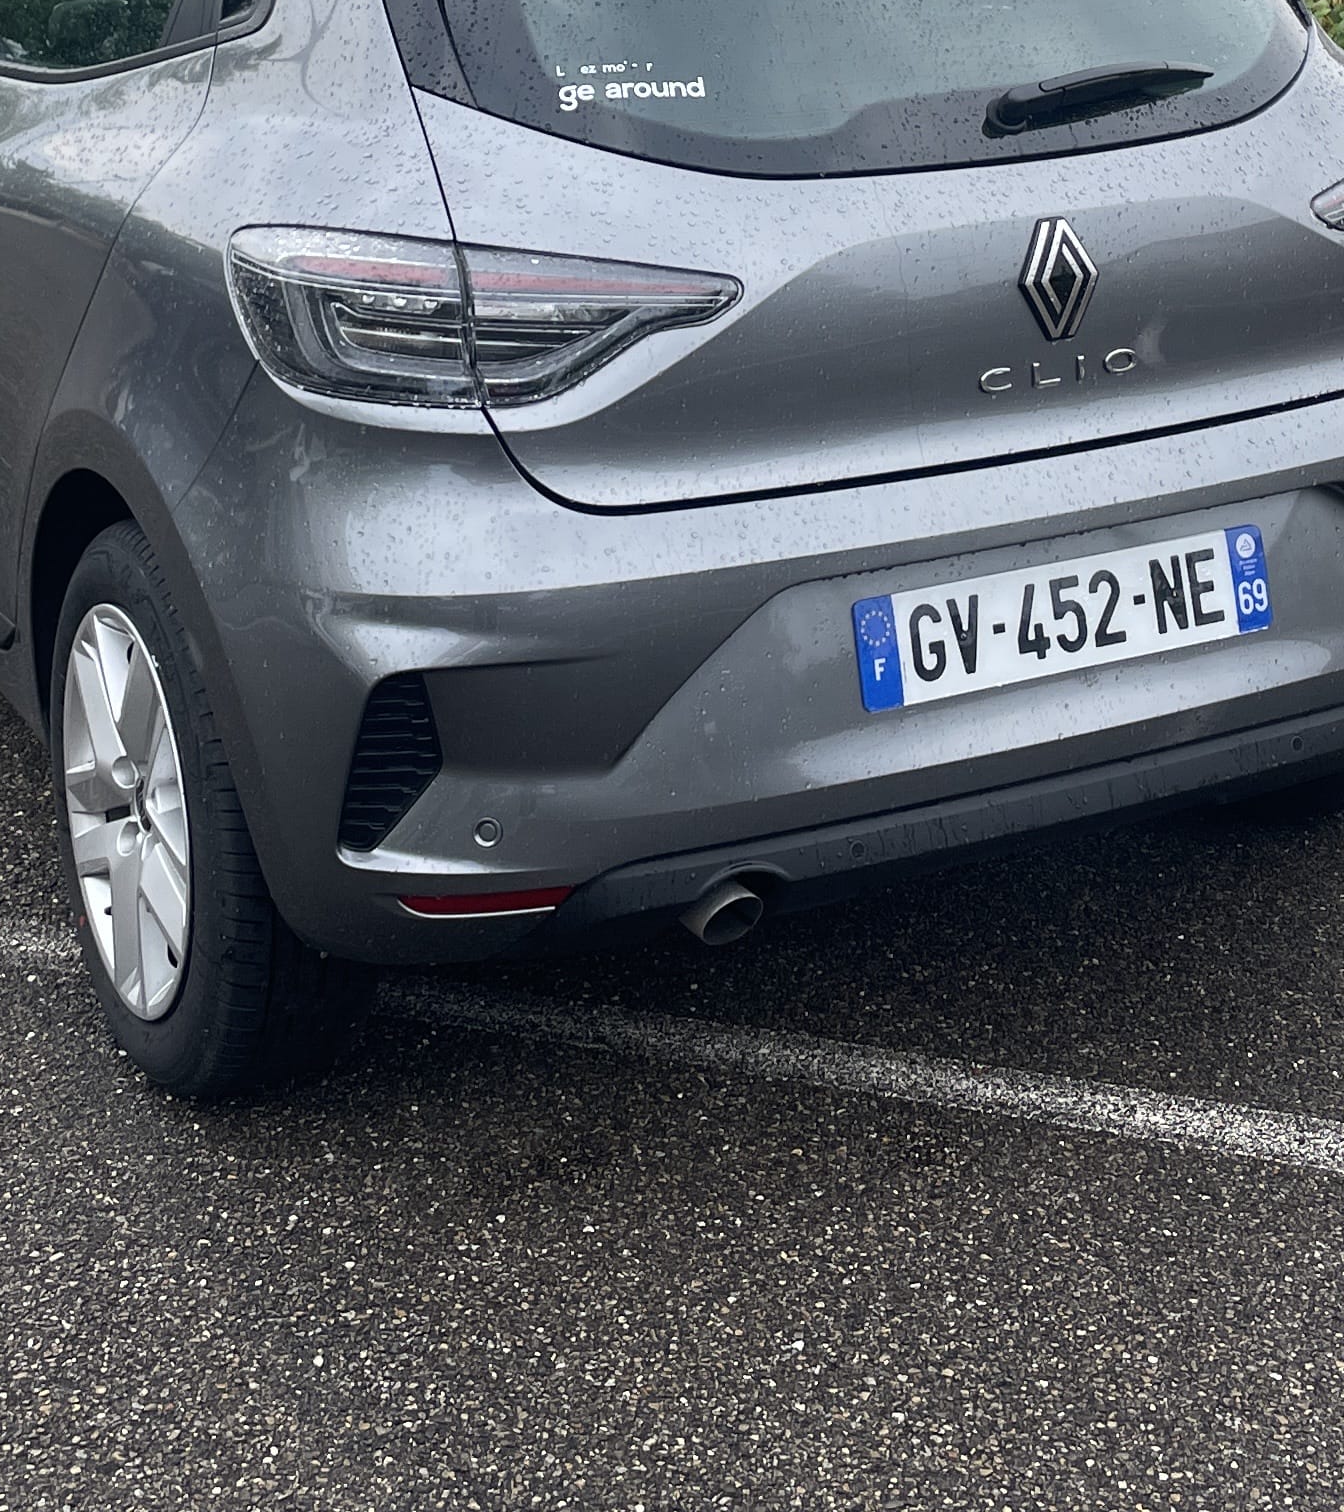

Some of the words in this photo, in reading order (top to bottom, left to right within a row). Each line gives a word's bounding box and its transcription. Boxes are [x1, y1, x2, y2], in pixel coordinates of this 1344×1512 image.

[978, 347, 1139, 394] CLIO
[873, 657, 887, 682] F
[908, 548, 1226, 683] GV-452-NE
[1237, 577, 1269, 616] 69
